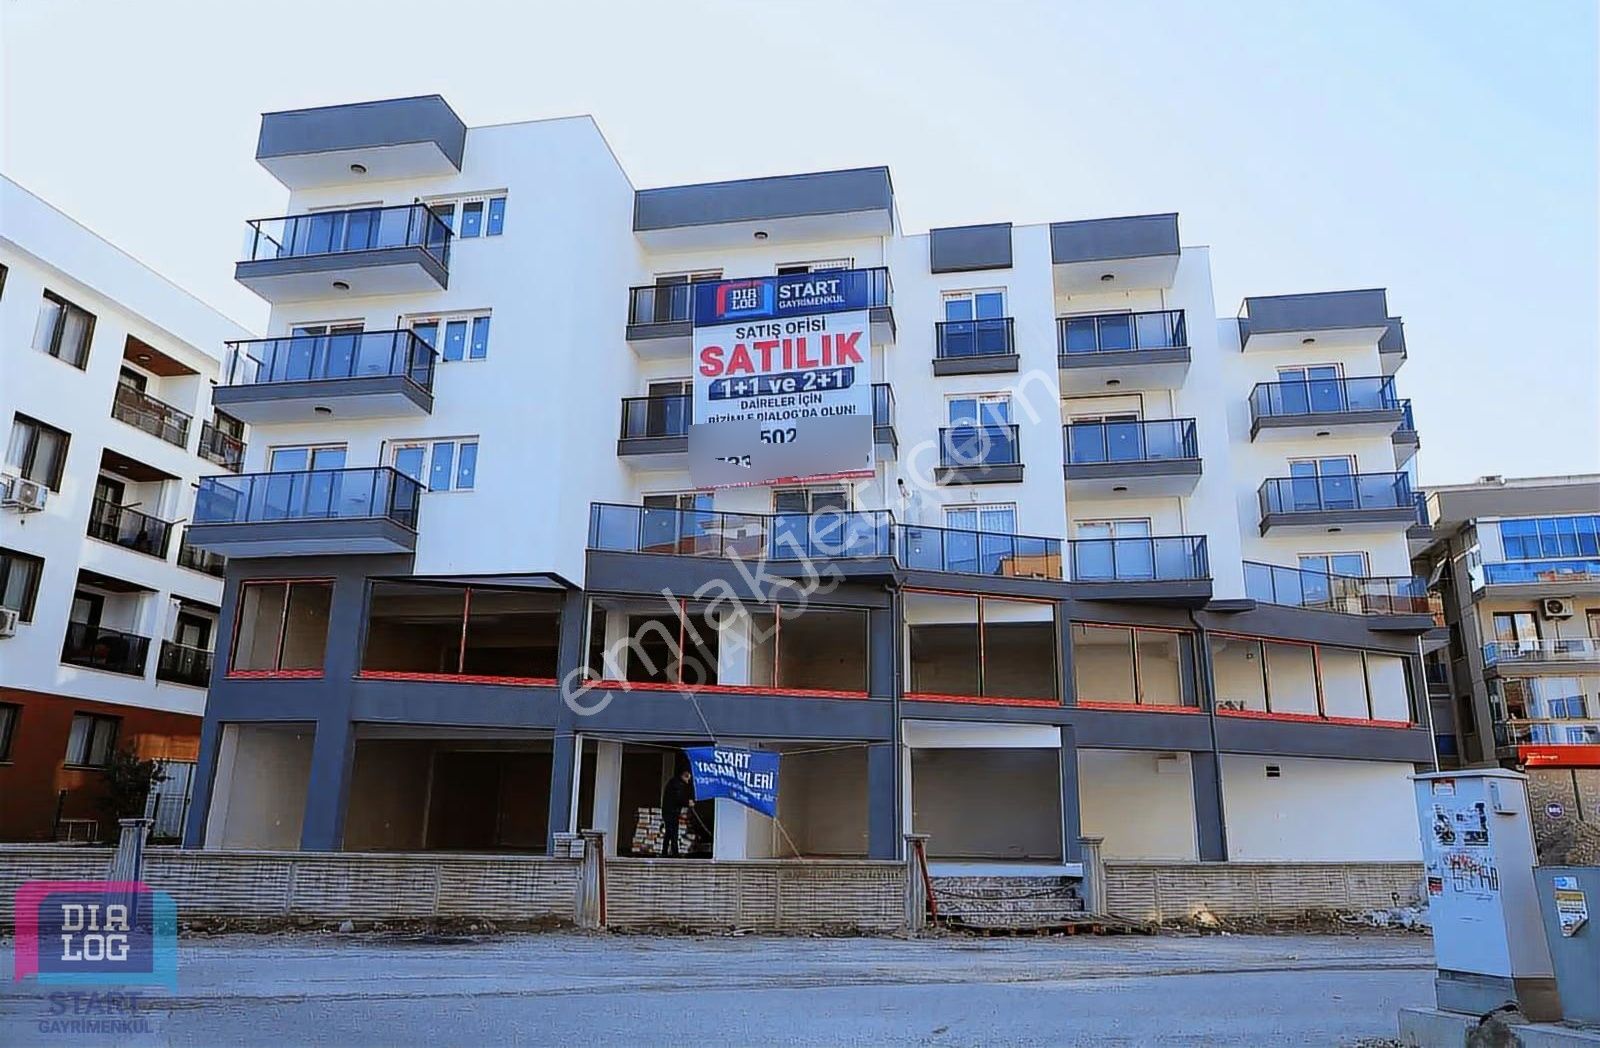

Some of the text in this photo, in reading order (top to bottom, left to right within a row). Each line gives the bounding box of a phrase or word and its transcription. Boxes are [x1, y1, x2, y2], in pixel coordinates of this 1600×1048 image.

[732, 287, 757, 300] DIA
[779, 279, 840, 299] START
[731, 299, 757, 310] LOG
[735, 316, 826, 340] SATIŞ OFİSİ
[700, 331, 864, 377] SATILIK
[721, 370, 843, 398] 1+1 ve 2+1
[740, 393, 822, 410] DAİRELER İÇİN
[821, 404, 856, 416] OLUN!
[714, 751, 752, 769] START
